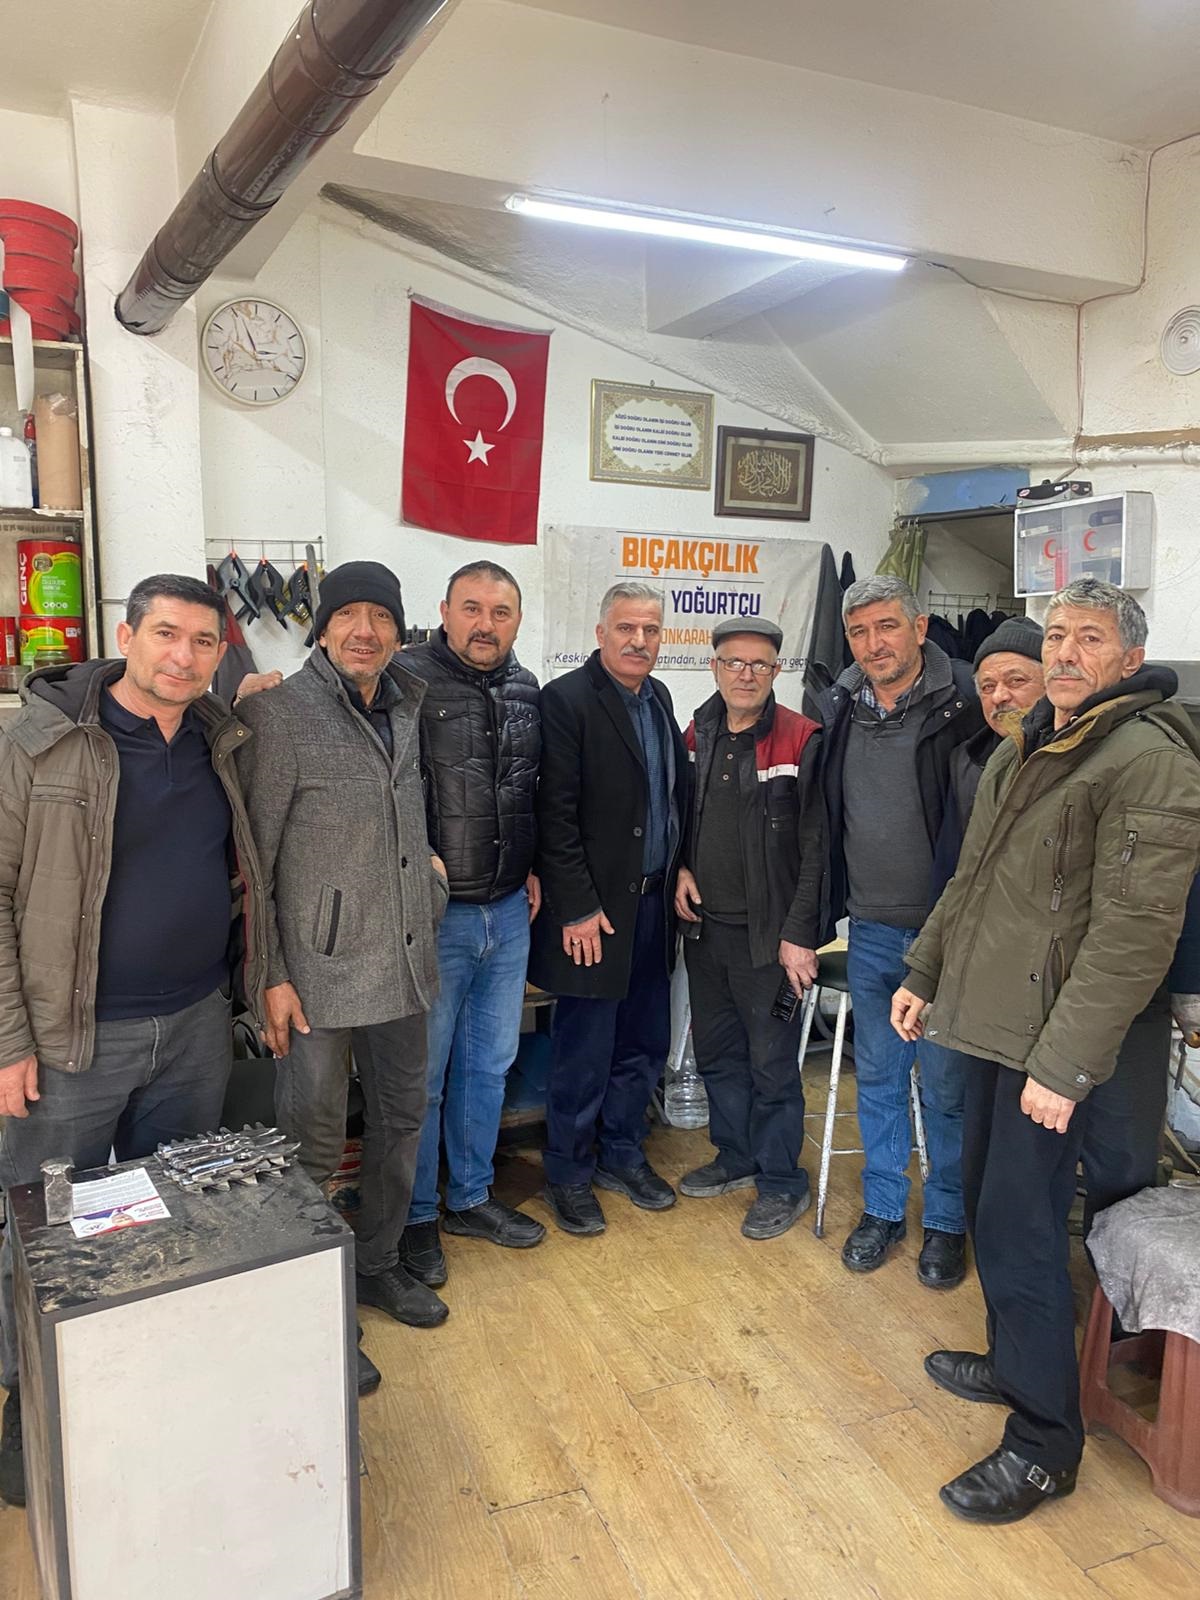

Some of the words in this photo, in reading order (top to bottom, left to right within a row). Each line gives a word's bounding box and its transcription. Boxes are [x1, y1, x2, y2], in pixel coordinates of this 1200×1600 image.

[622, 536, 760, 578] BIÇAKÇILIK
[671, 586, 761, 617] YOĞURTÇU
[660, 627, 712, 646] ONKARAH
[657, 655, 697, 666] atından,
